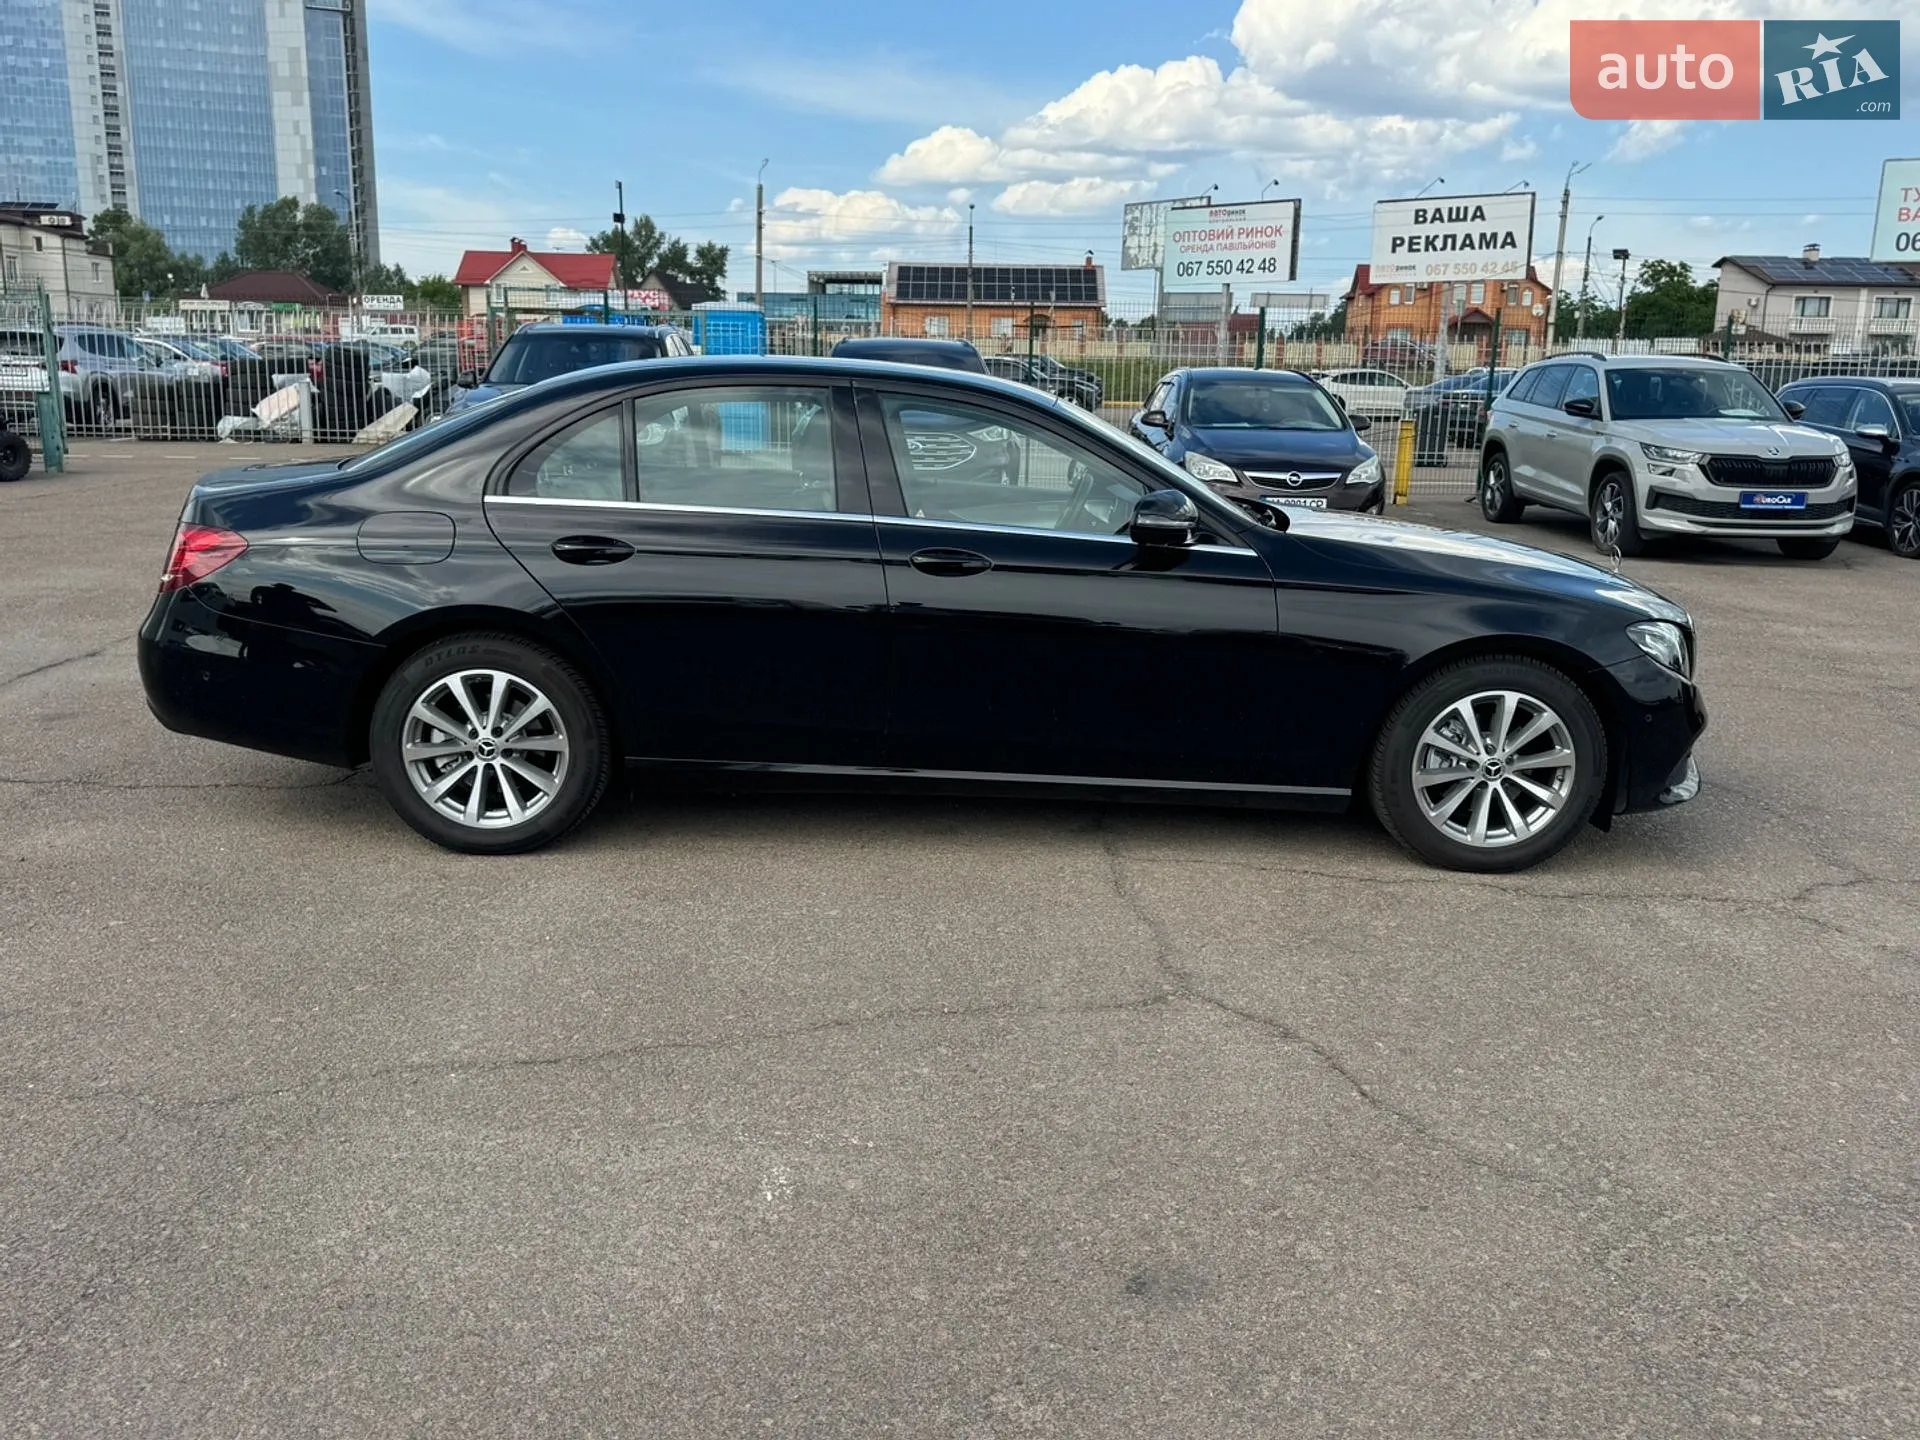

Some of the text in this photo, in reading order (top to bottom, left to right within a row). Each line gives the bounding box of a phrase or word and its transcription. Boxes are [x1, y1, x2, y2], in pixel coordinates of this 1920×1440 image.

[1414, 205, 1486, 225] ВАША
[1173, 224, 1283, 243] ОПТОВИЙ РИНОК
[1391, 231, 1517, 253] РЕКЛАМА
[1180, 240, 1276, 254] ОРЕНДА ПАВІЛЬЙОНІВ
[1177, 257, 1277, 277] 067 550 42 48
[1425, 263, 1450, 276] 067
[1452, 262, 1477, 275] 550
[1481, 261, 1497, 275] 42
[363, 296, 402, 304] ОРЕНДА
